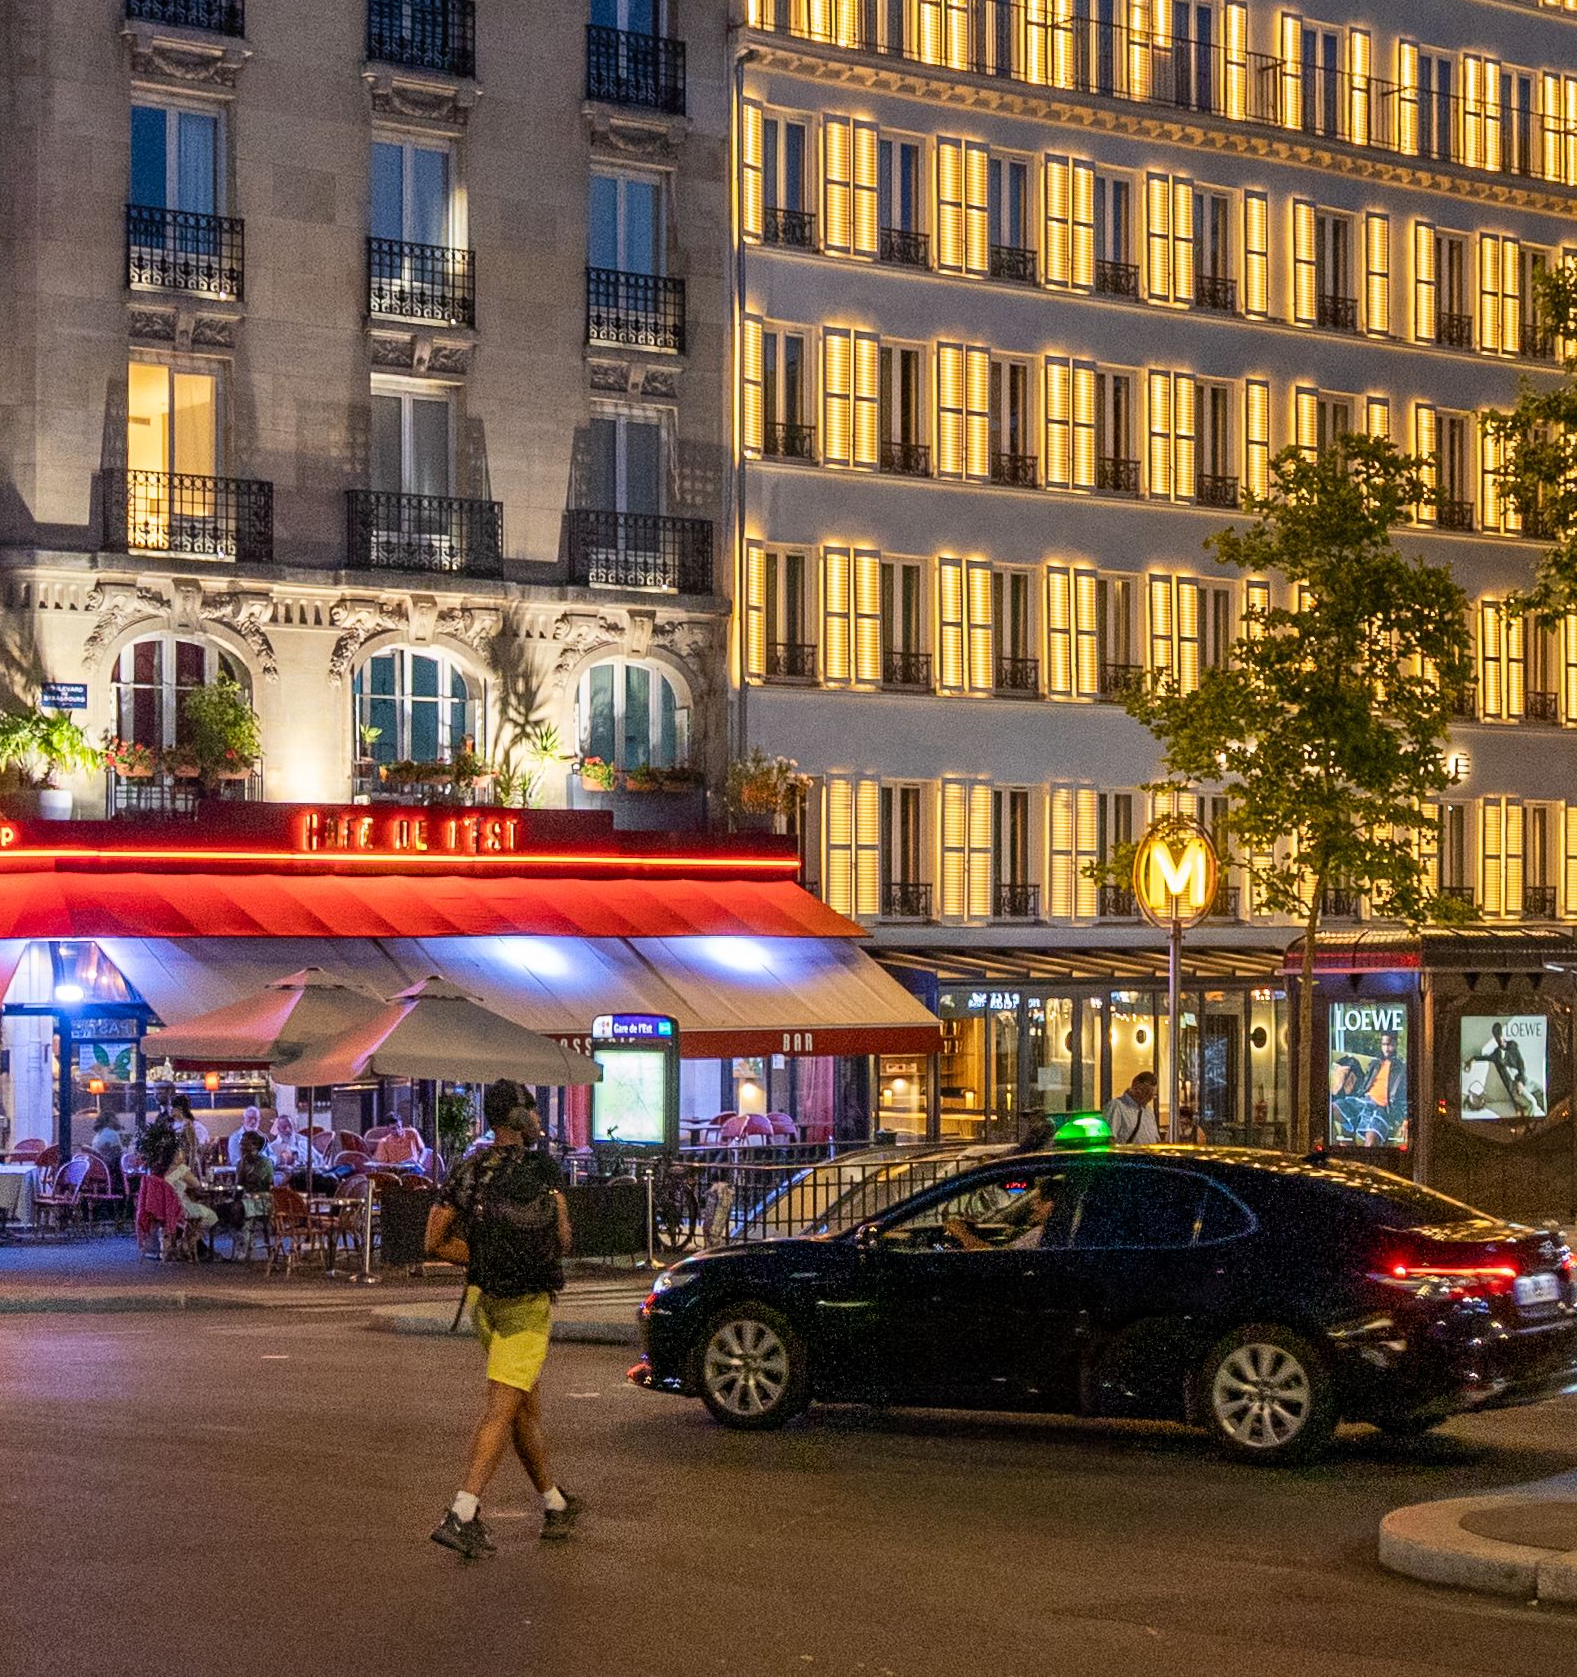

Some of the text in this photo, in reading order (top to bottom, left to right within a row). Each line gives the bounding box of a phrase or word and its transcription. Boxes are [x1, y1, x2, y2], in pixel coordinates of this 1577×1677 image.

[1149, 838, 1207, 909] M
[613, 1022, 653, 1034] Gare de l'Est
[1335, 1009, 1404, 1031] LOEWE
[1505, 1022, 1543, 1037] LOEWE
[783, 1033, 813, 1052] BAR
